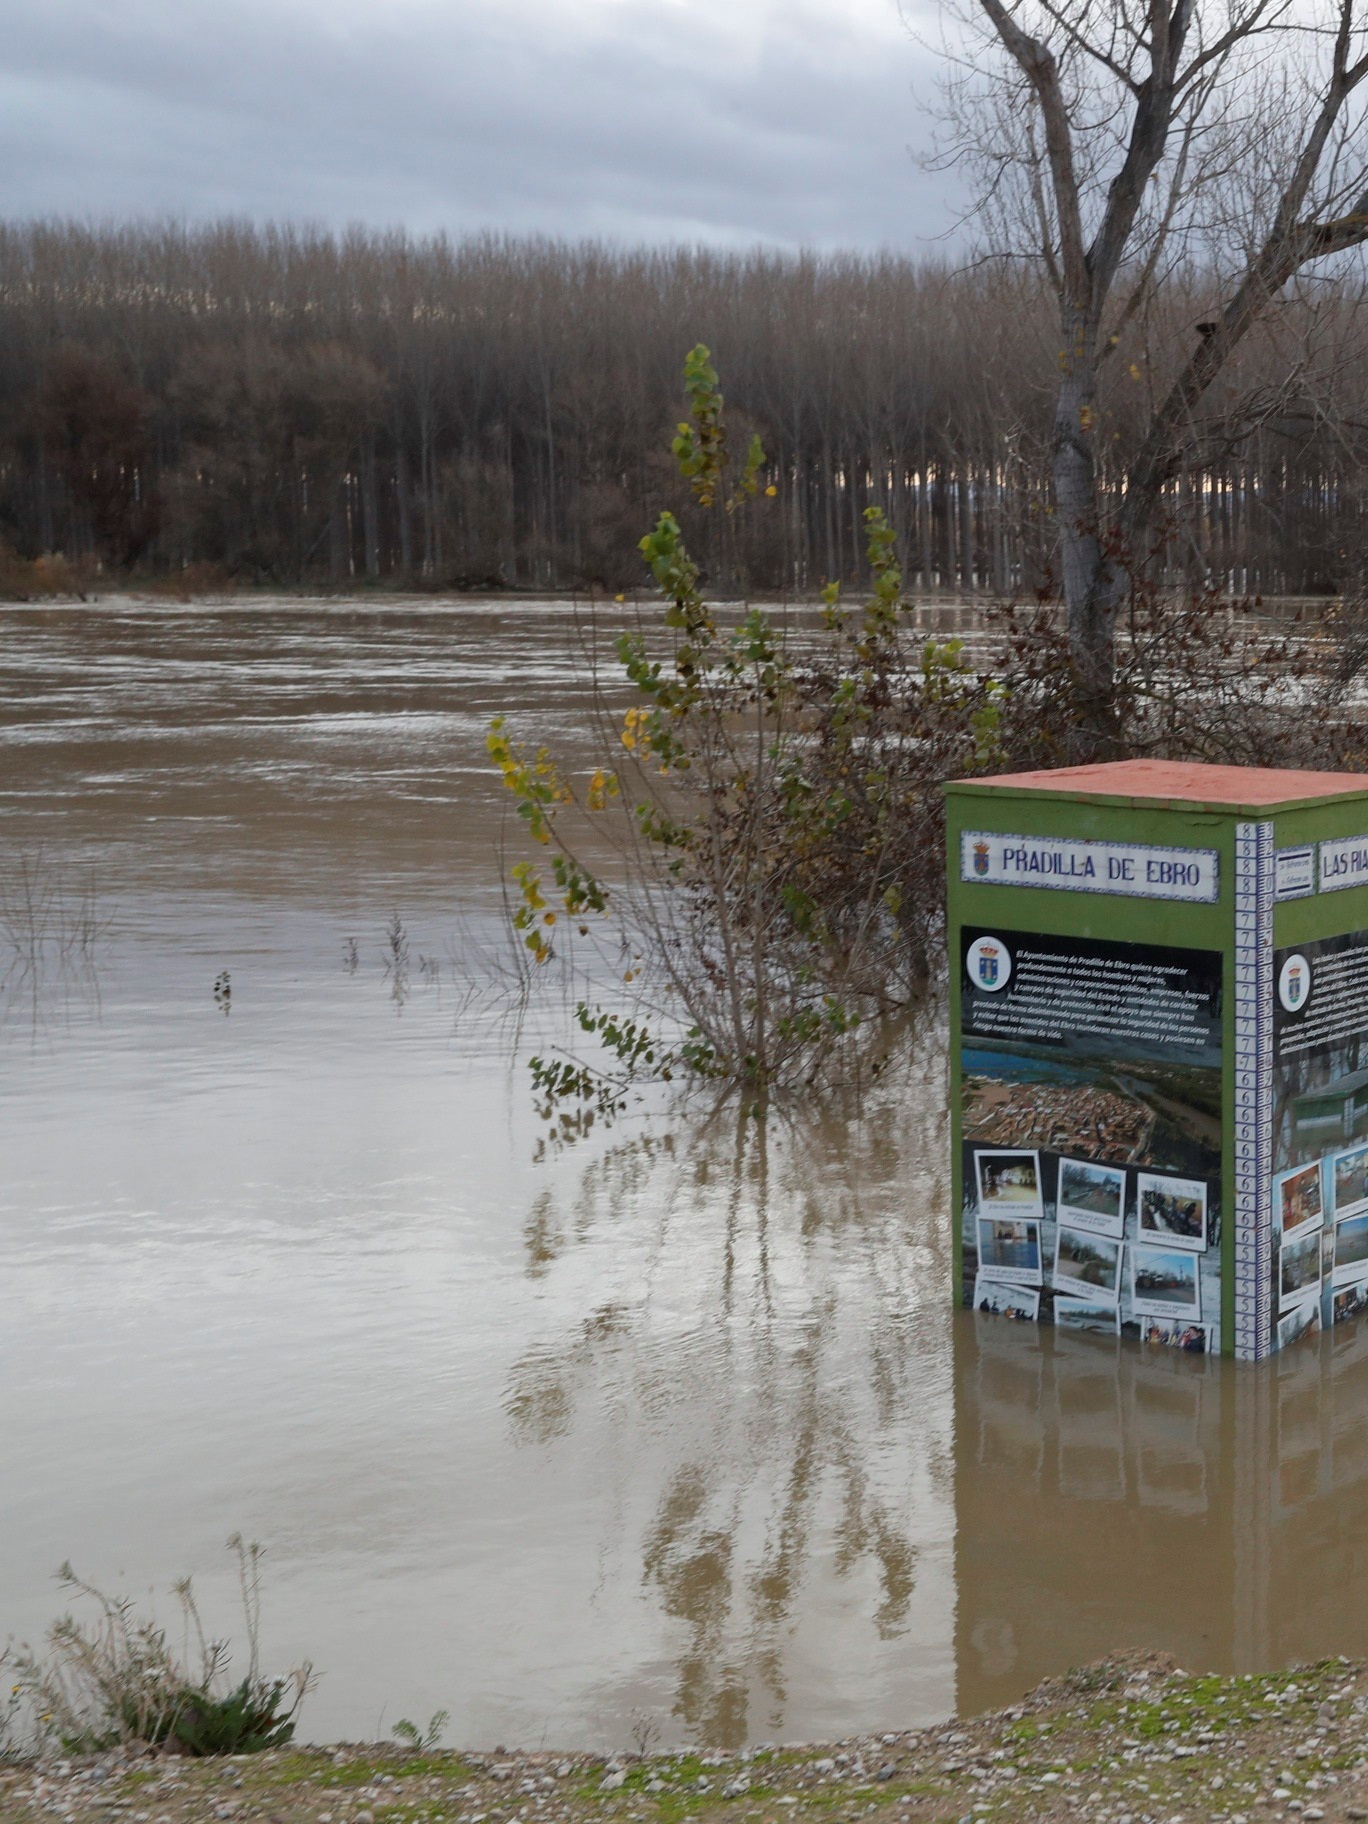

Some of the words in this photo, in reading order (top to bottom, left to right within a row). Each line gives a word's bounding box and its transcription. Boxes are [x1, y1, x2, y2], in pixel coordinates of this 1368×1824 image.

[1243, 823, 1250, 838] 8
[1243, 841, 1250, 856] 8
[1003, 846, 1096, 877] PRADILLA
[1108, 857, 1134, 880] DE
[1146, 860, 1200, 886] EBRO
[1243, 859, 1250, 874] 8
[1323, 853, 1348, 878] LAS
[1243, 877, 1250, 893] 8
[1241, 896, 1250, 909] 7
[1241, 913, 1250, 927] 7
[1241, 931, 1250, 945] 7
[1241, 949, 1250, 962] 7
[1241, 966, 1250, 980] 7
[1241, 984, 1250, 998] 7
[1241, 1002, 1250, 1016] 7
[1241, 1019, 1250, 1033] 7
[1241, 1037, 1250, 1051] 7
[1241, 1055, 1250, 1069] 7
[1242, 1073, 1250, 1086] 6
[1242, 1091, 1250, 1104] 6
[1242, 1108, 1250, 1122] 6
[1242, 1125, 1250, 1139] 6
[1242, 1143, 1250, 1157] 6
[1242, 1160, 1250, 1173] 6
[1242, 1177, 1250, 1191] 6
[1242, 1195, 1250, 1208] 6
[1242, 1213, 1250, 1226] 6
[1242, 1230, 1250, 1243] 6
[1242, 1246, 1248, 1260] 5
[1242, 1263, 1248, 1277] 5
[1242, 1281, 1248, 1295] 5
[1242, 1298, 1248, 1312] 5
[1242, 1315, 1248, 1329] 5
[1242, 1332, 1248, 1345] 5
